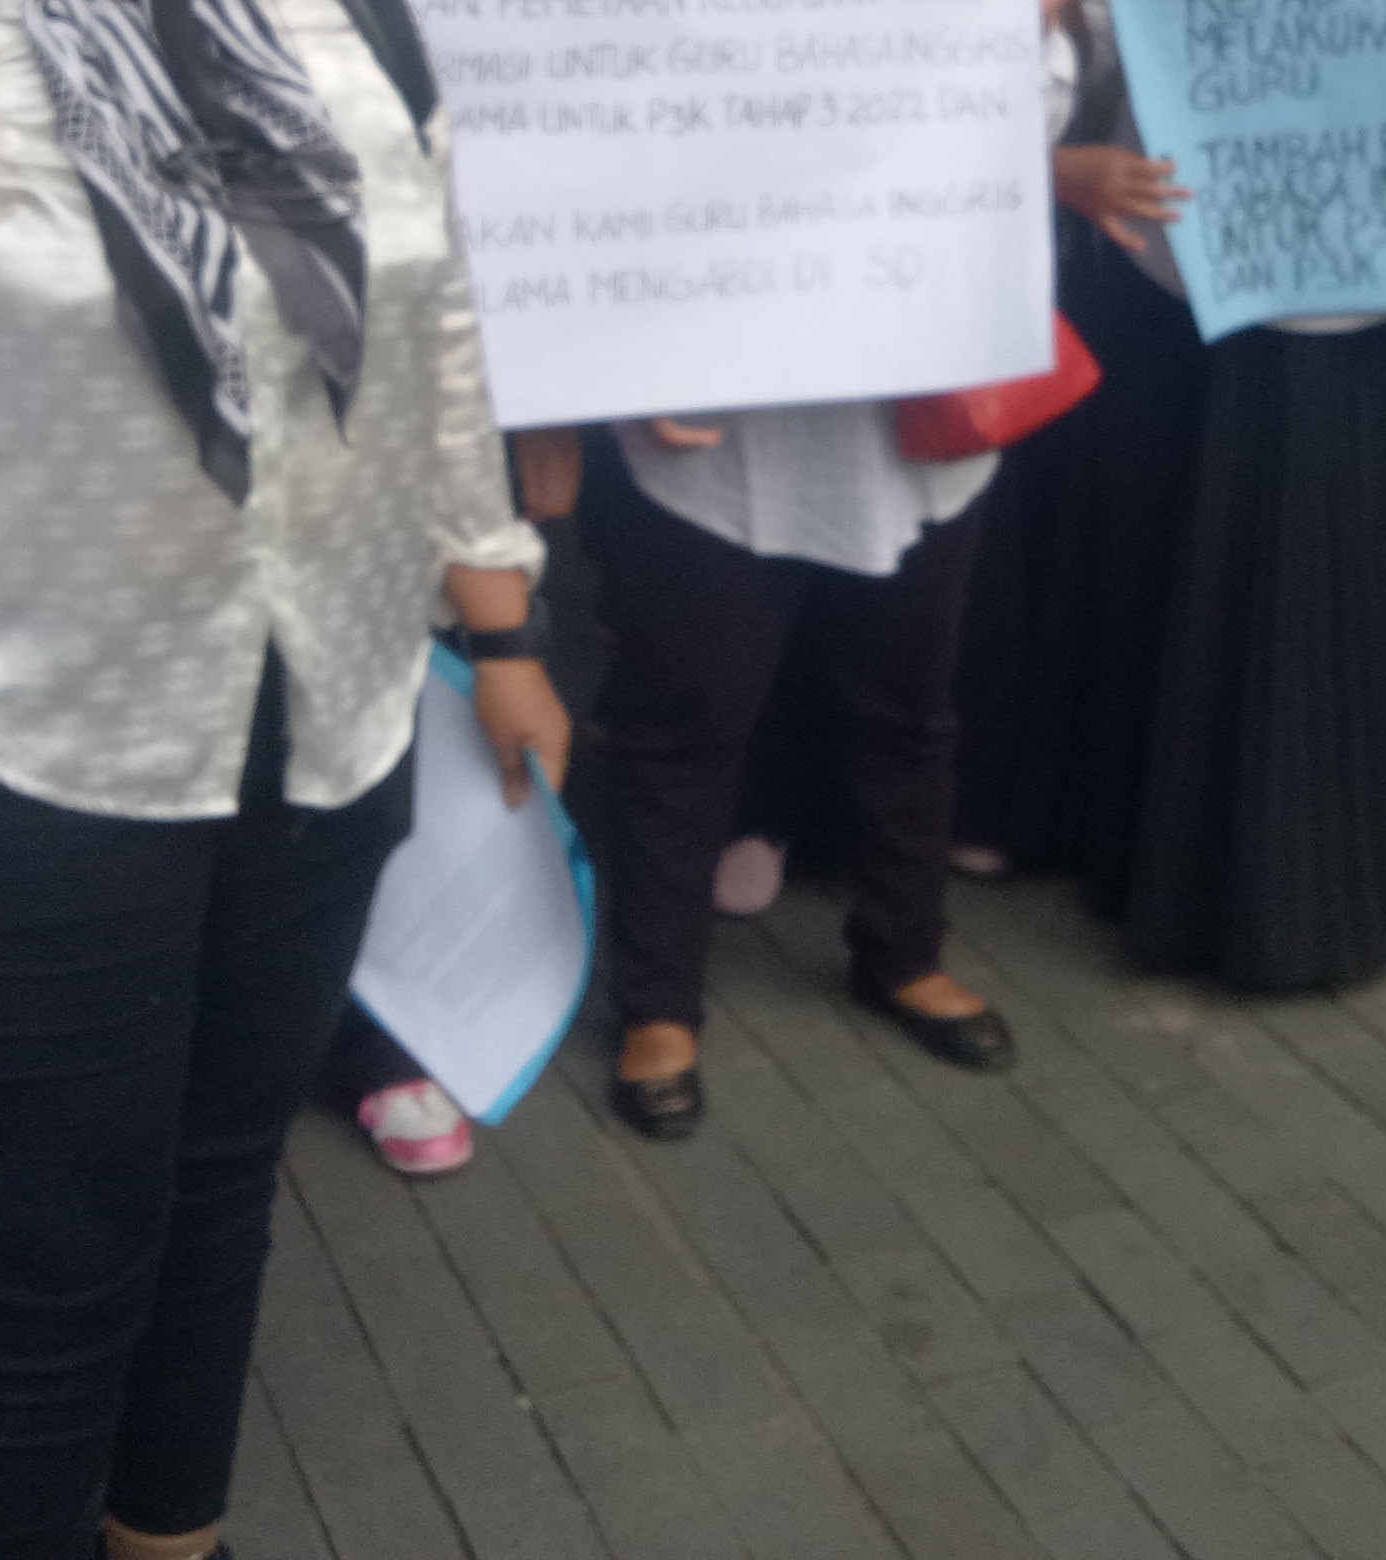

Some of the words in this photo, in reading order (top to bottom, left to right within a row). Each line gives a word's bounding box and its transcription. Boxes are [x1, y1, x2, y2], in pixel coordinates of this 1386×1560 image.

[439, 50, 531, 85] RMASI
[545, 42, 657, 79] UNTUK
[668, 37, 761, 76] GURU
[447, 102, 527, 136] AMA
[539, 100, 635, 134] UNTUK
[847, 85, 929, 128] 2022
[938, 85, 1009, 122] DAN
[1187, 59, 1321, 115] GURU
[575, 209, 655, 242] KAMI
[664, 200, 748, 234] GURU
[757, 190, 880, 230] BAHASA
